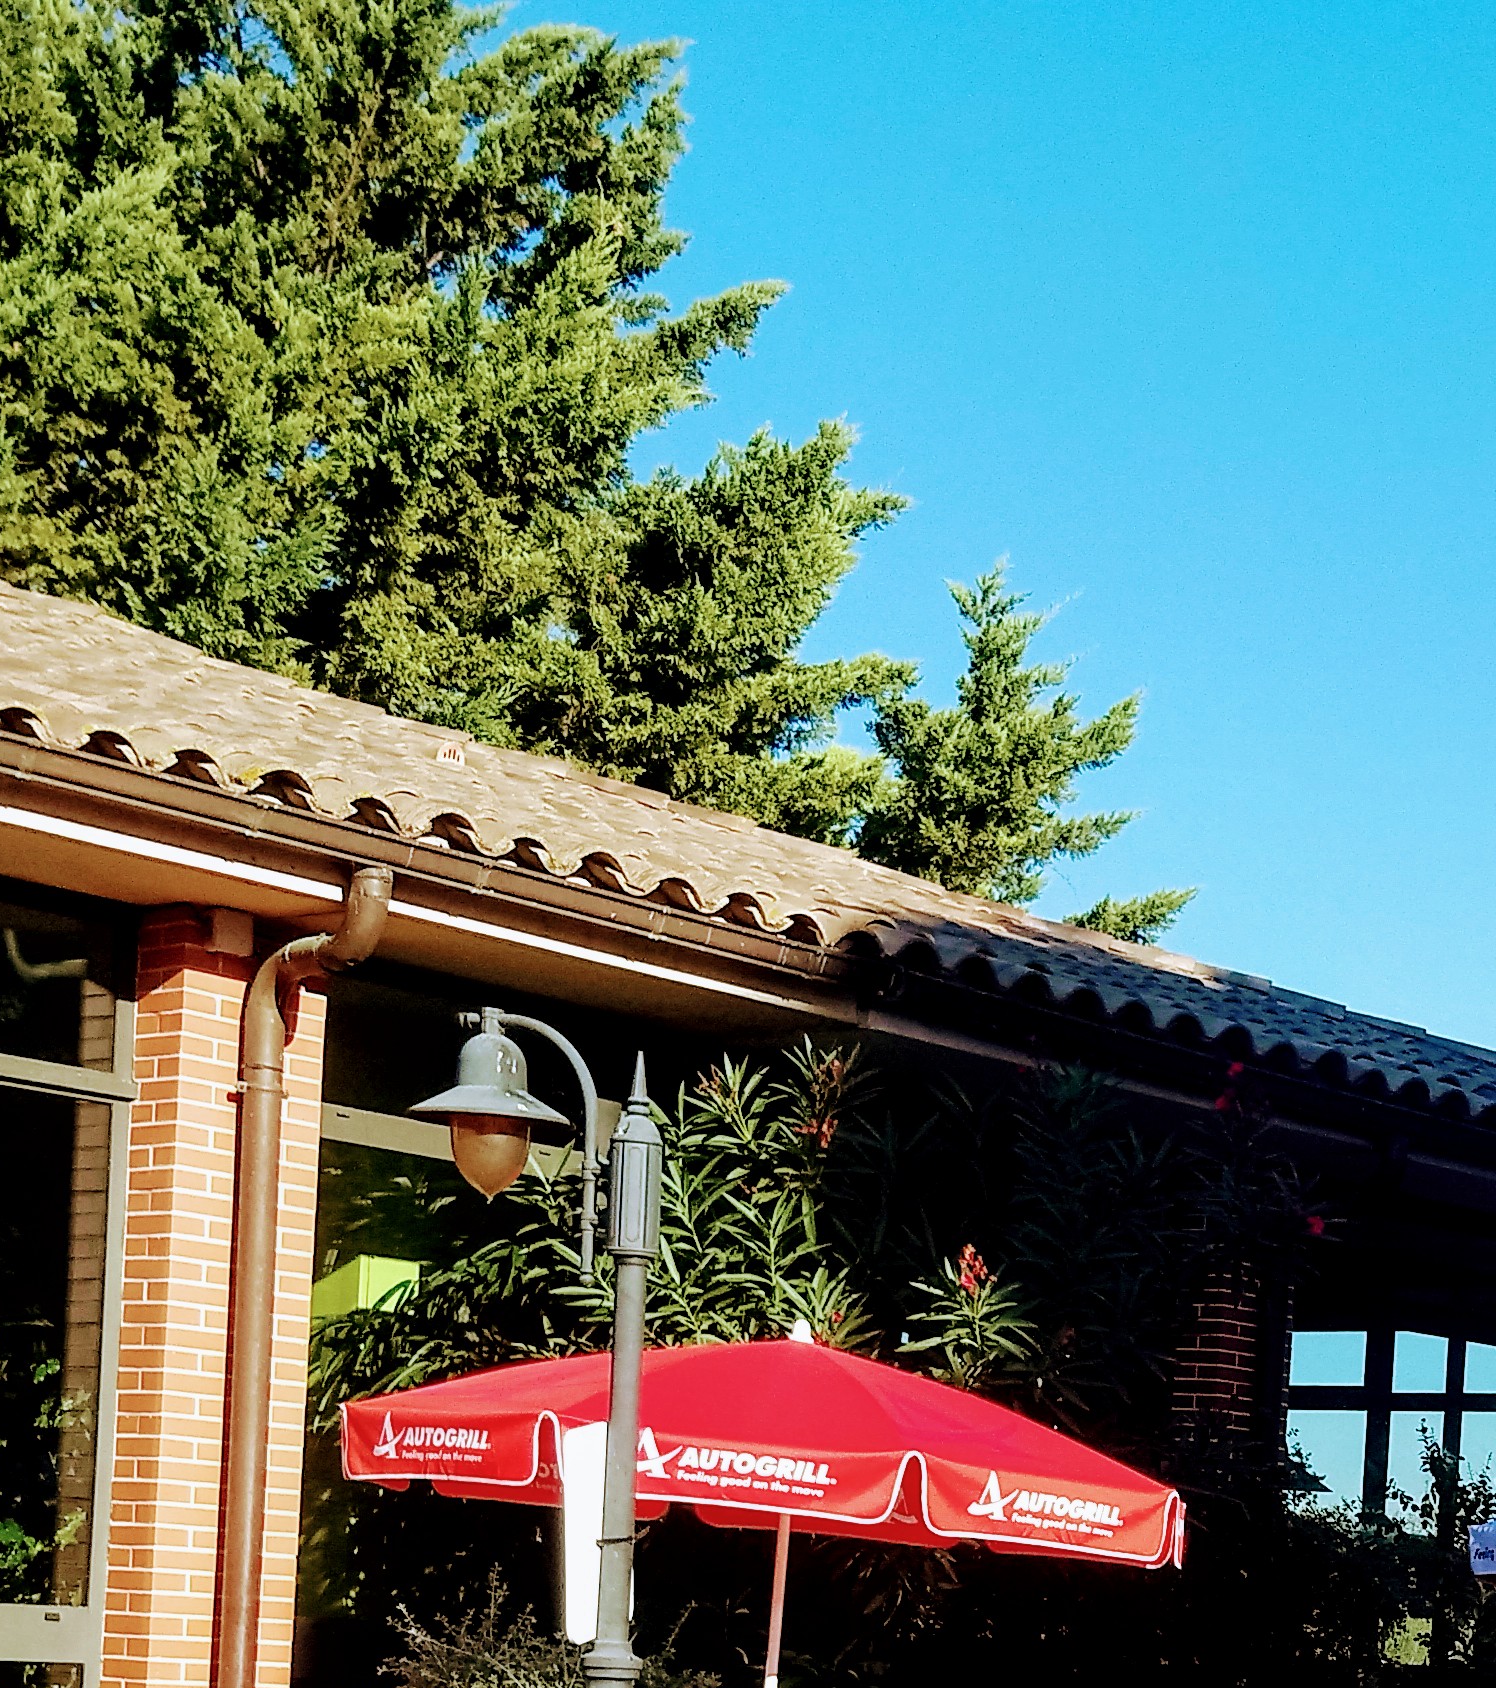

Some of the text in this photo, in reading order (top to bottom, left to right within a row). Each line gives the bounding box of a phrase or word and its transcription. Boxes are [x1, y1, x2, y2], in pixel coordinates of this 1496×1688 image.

[676, 1469, 824, 1498] Feeling good on the move
[1011, 1512, 1042, 1528] Feeling
[1042, 1518, 1065, 1530] good
[1065, 1521, 1078, 1531] on
[1078, 1522, 1092, 1533] the
